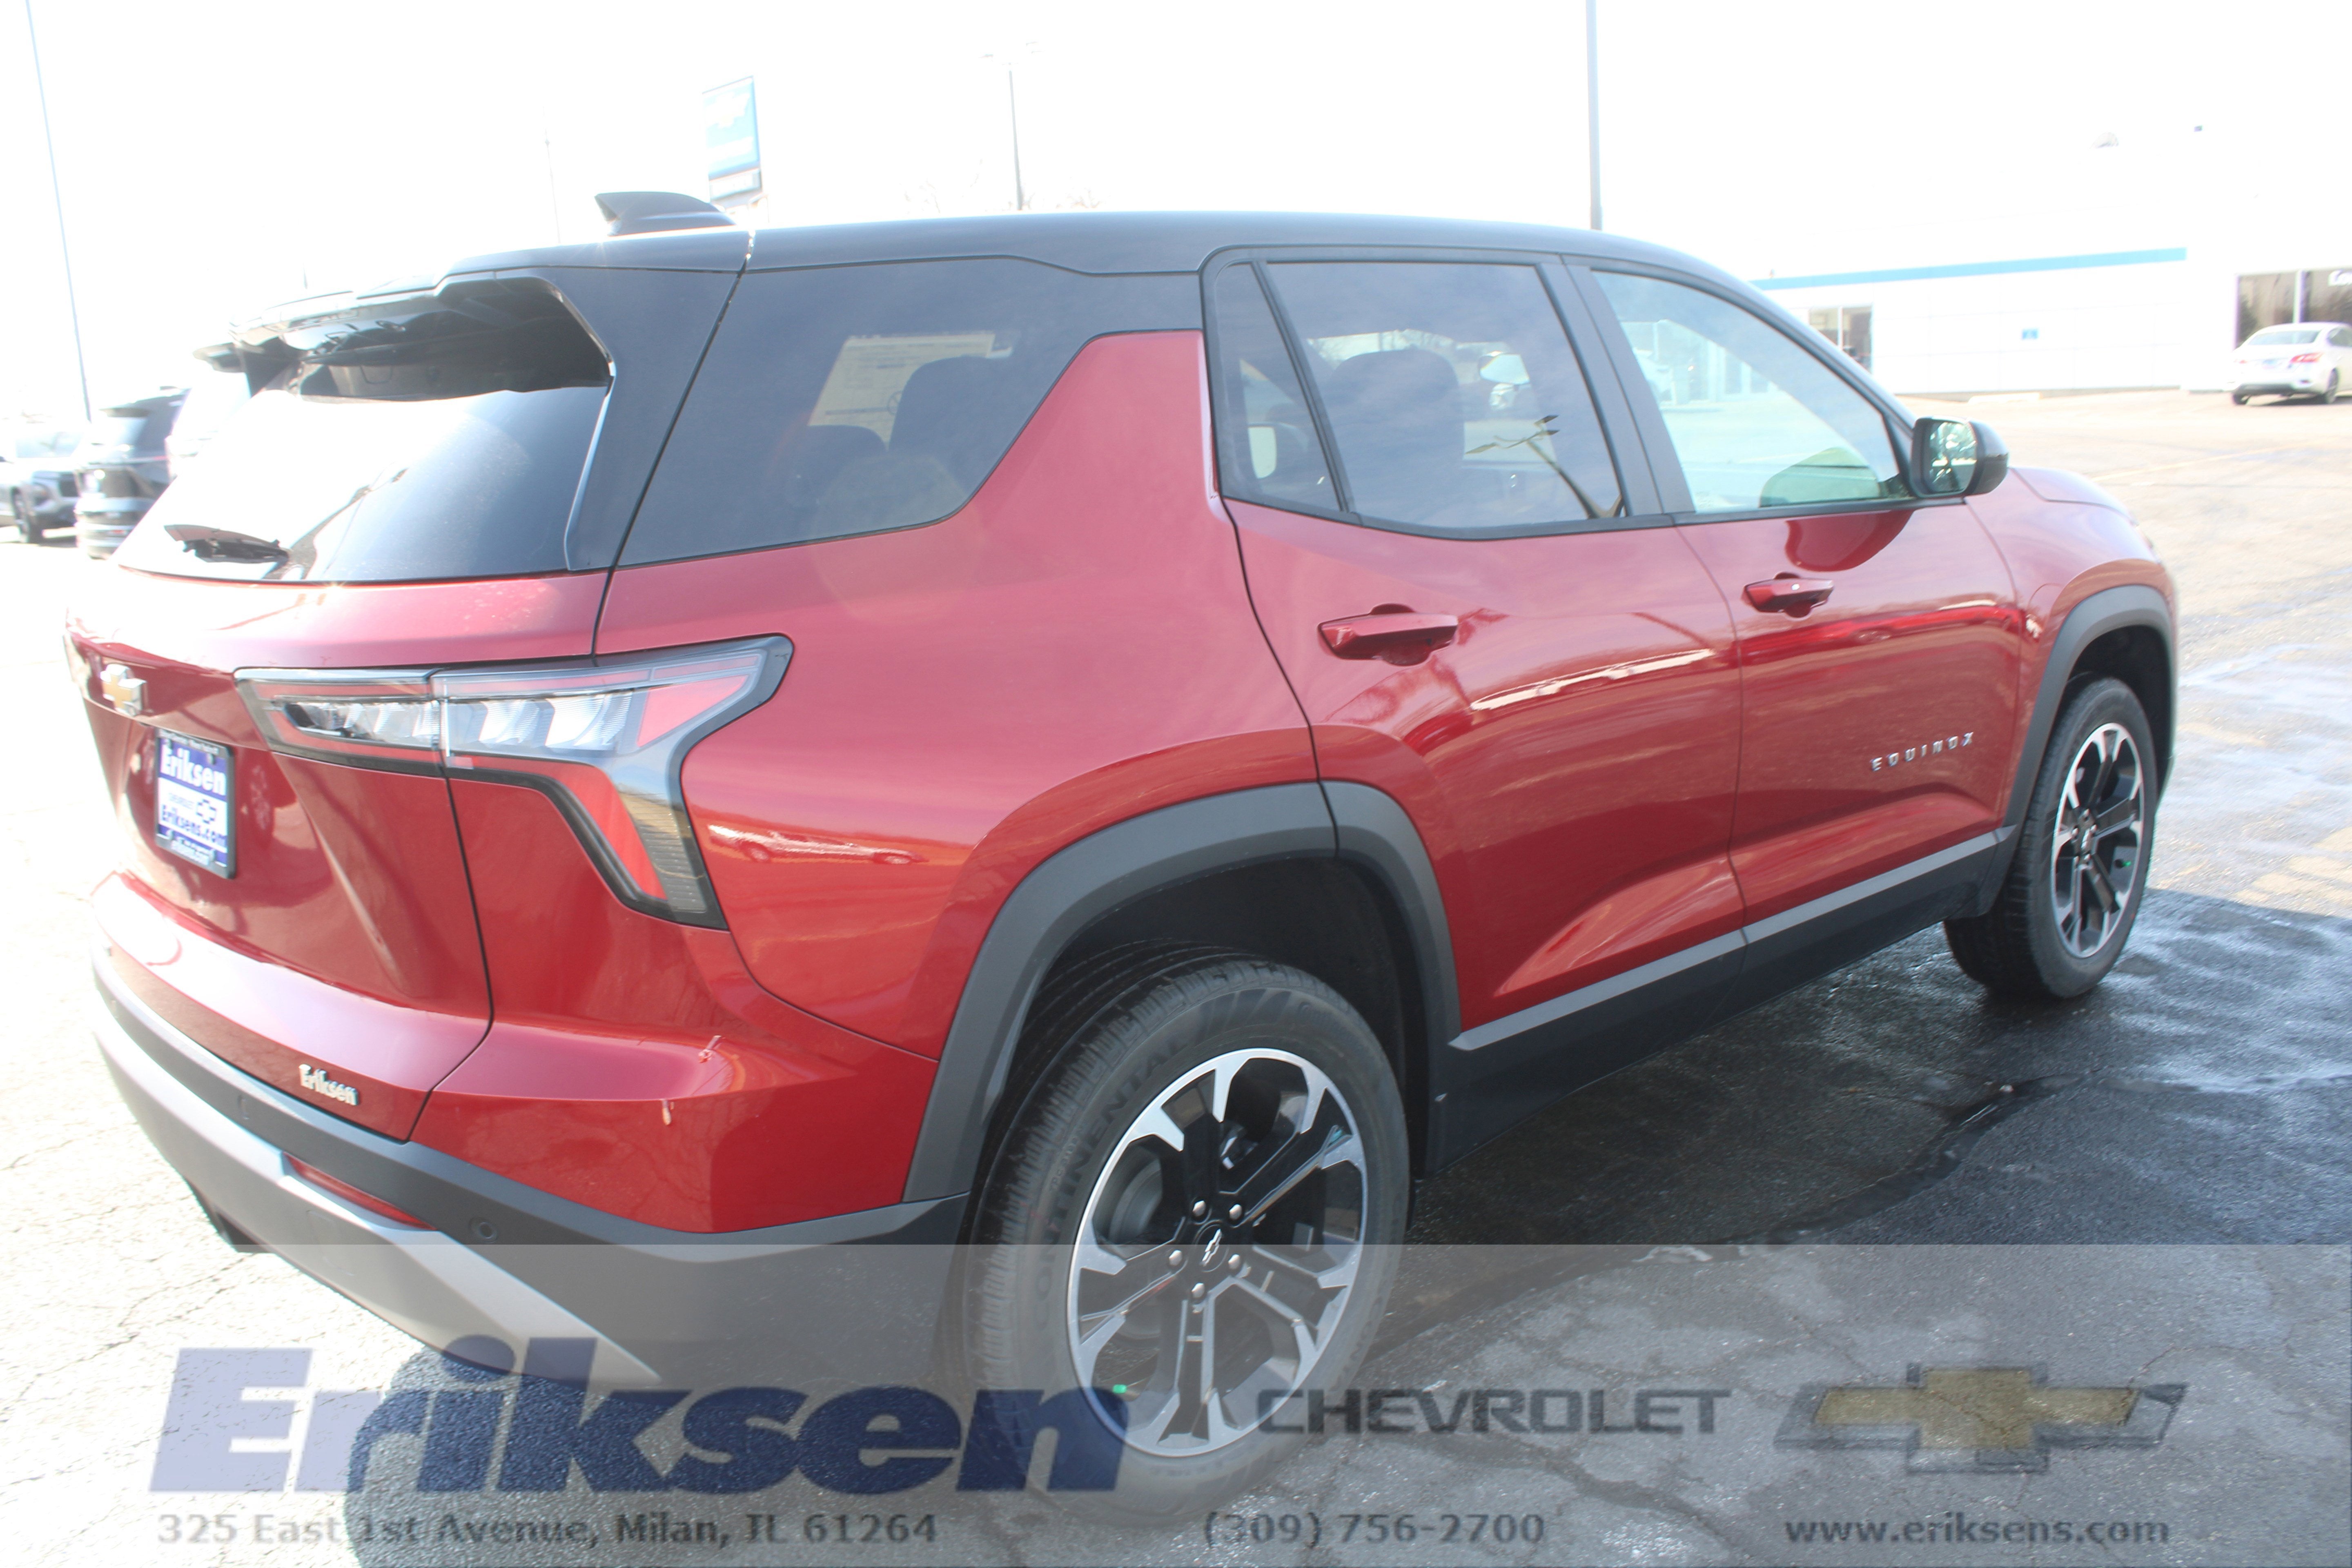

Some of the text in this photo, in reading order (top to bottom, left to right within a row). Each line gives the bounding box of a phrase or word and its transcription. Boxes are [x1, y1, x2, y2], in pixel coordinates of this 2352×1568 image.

[160, 742, 227, 796] Eriksen
[1869, 732, 1973, 772] EQUINOX
[298, 1064, 358, 1106] Eriksen
